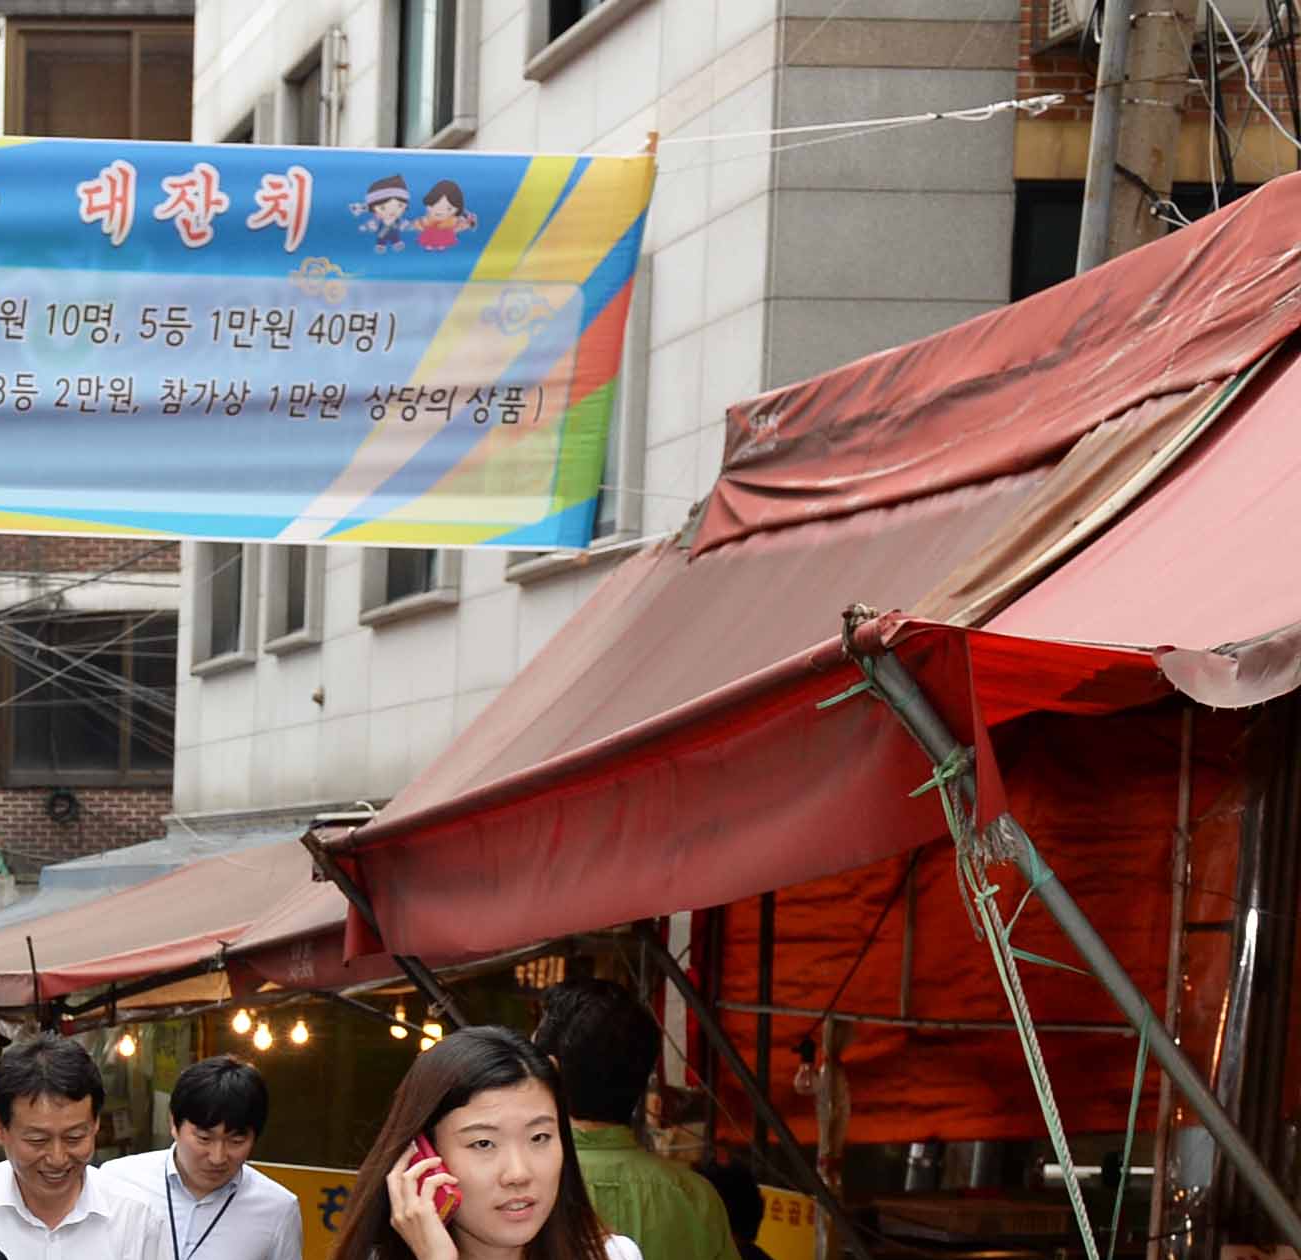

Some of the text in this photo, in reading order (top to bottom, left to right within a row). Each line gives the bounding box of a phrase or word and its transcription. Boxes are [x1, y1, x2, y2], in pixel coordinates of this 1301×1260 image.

[80, 159, 314, 250] 대잔치
[46, 303, 121, 344] 10명,
[138, 306, 193, 347] 5등
[212, 307, 294, 350] 1만원
[306, 312, 396, 353] 40명)
[54, 375, 140, 415] 2만원,
[160, 378, 251, 417] 참가상
[268, 382, 353, 420] 1만원
[362, 384, 459, 423] 상당의
[465, 383, 544, 425] 상품)
